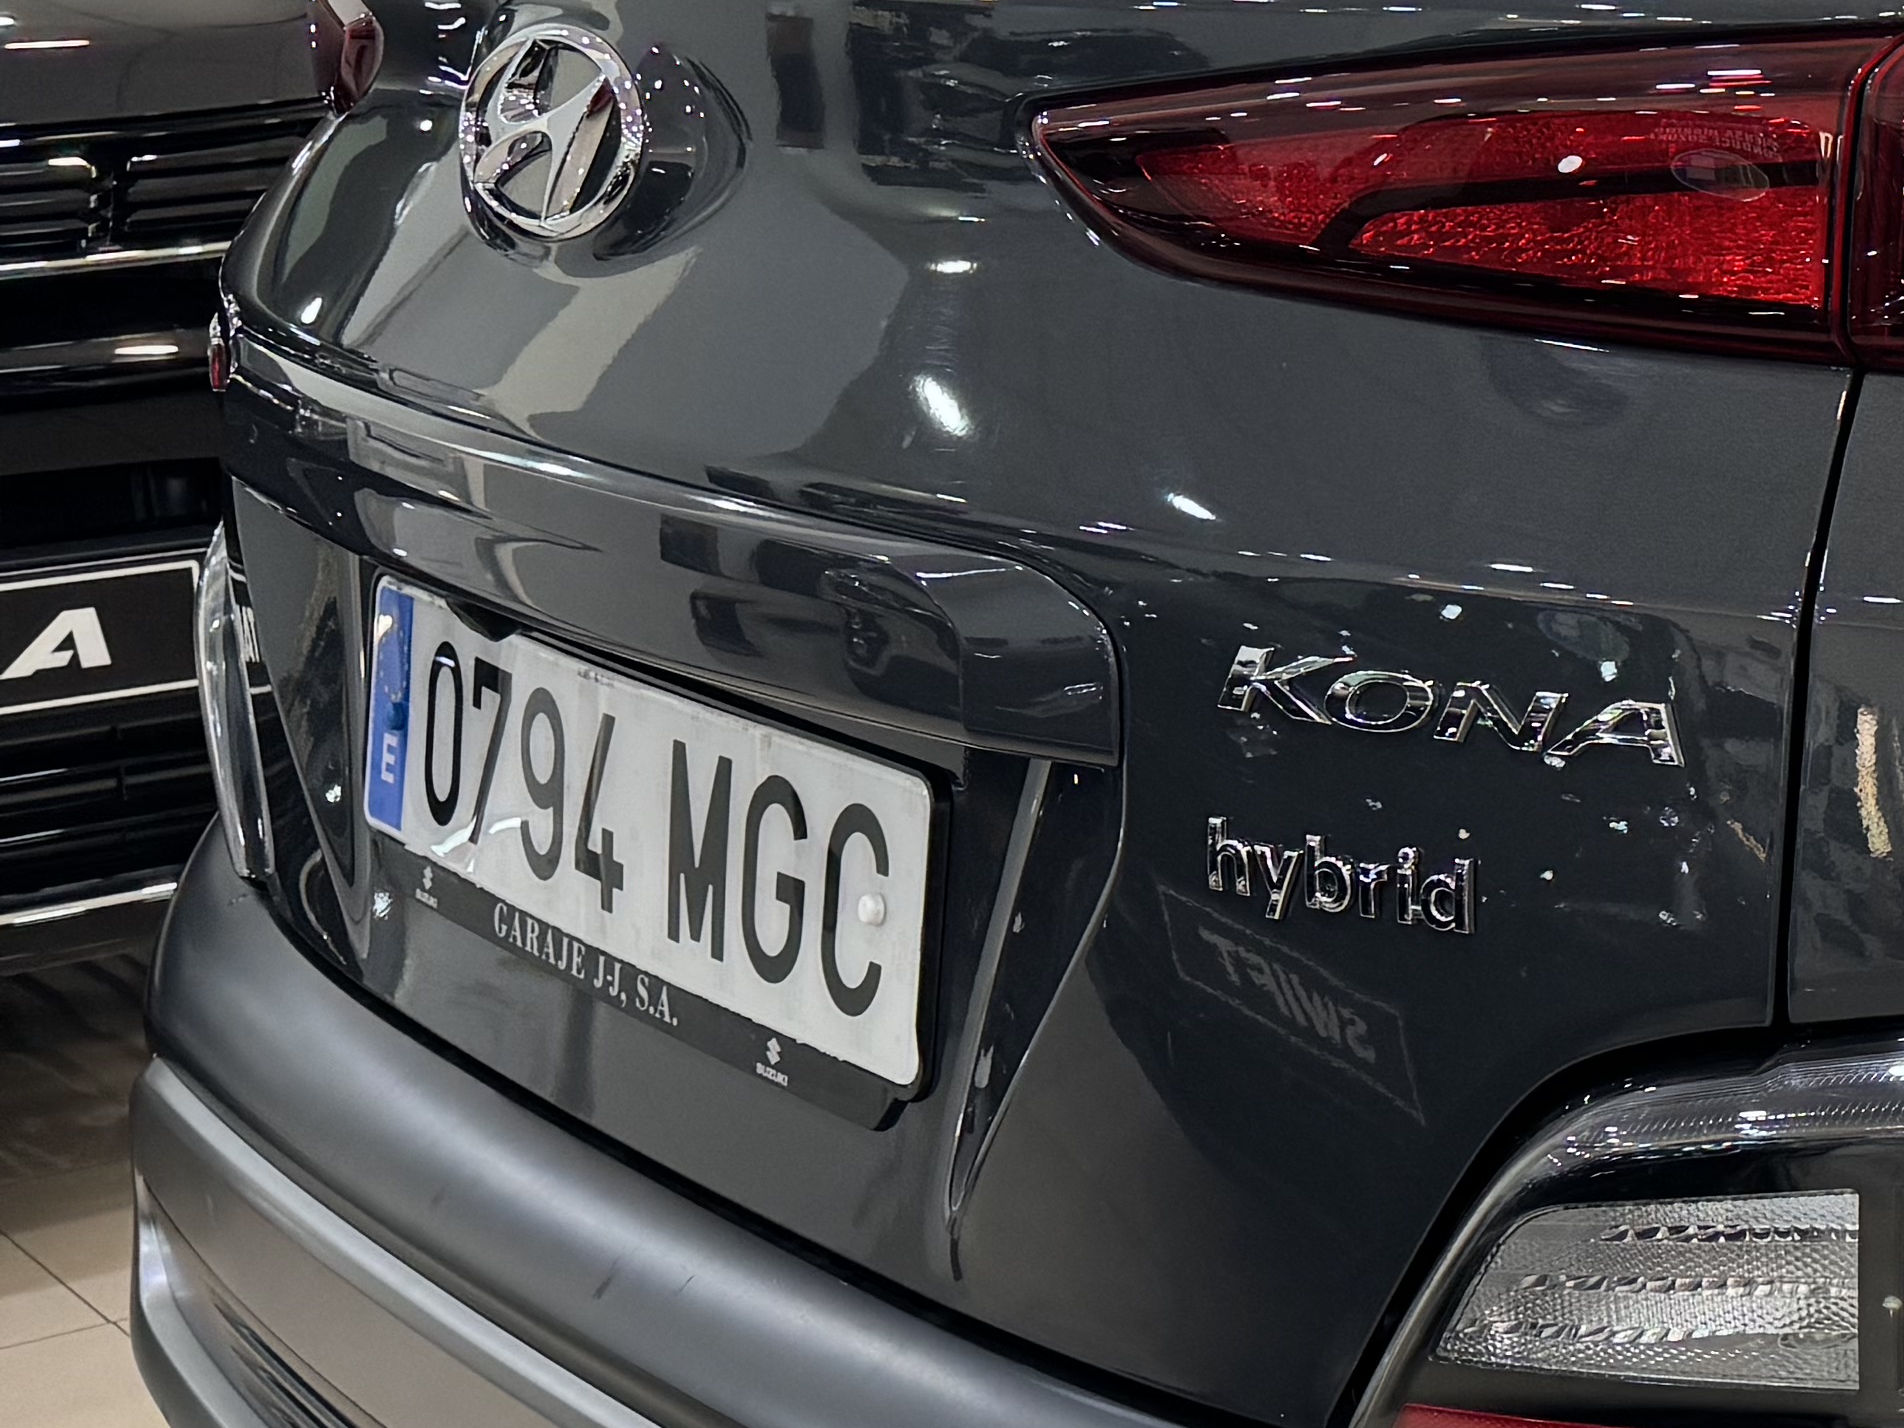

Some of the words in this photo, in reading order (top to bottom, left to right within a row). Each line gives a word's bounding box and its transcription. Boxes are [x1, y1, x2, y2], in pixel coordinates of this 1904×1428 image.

[1217, 644, 1686, 768] KONA
[380, 732, 398, 784] E
[424, 640, 625, 914] 0794
[667, 738, 889, 1018] MGC
[1206, 816, 1479, 935] hybrid
[493, 902, 586, 980] GARAJE
[635, 973, 679, 1026] S.A.
[755, 1061, 789, 1087] SUZUKI
